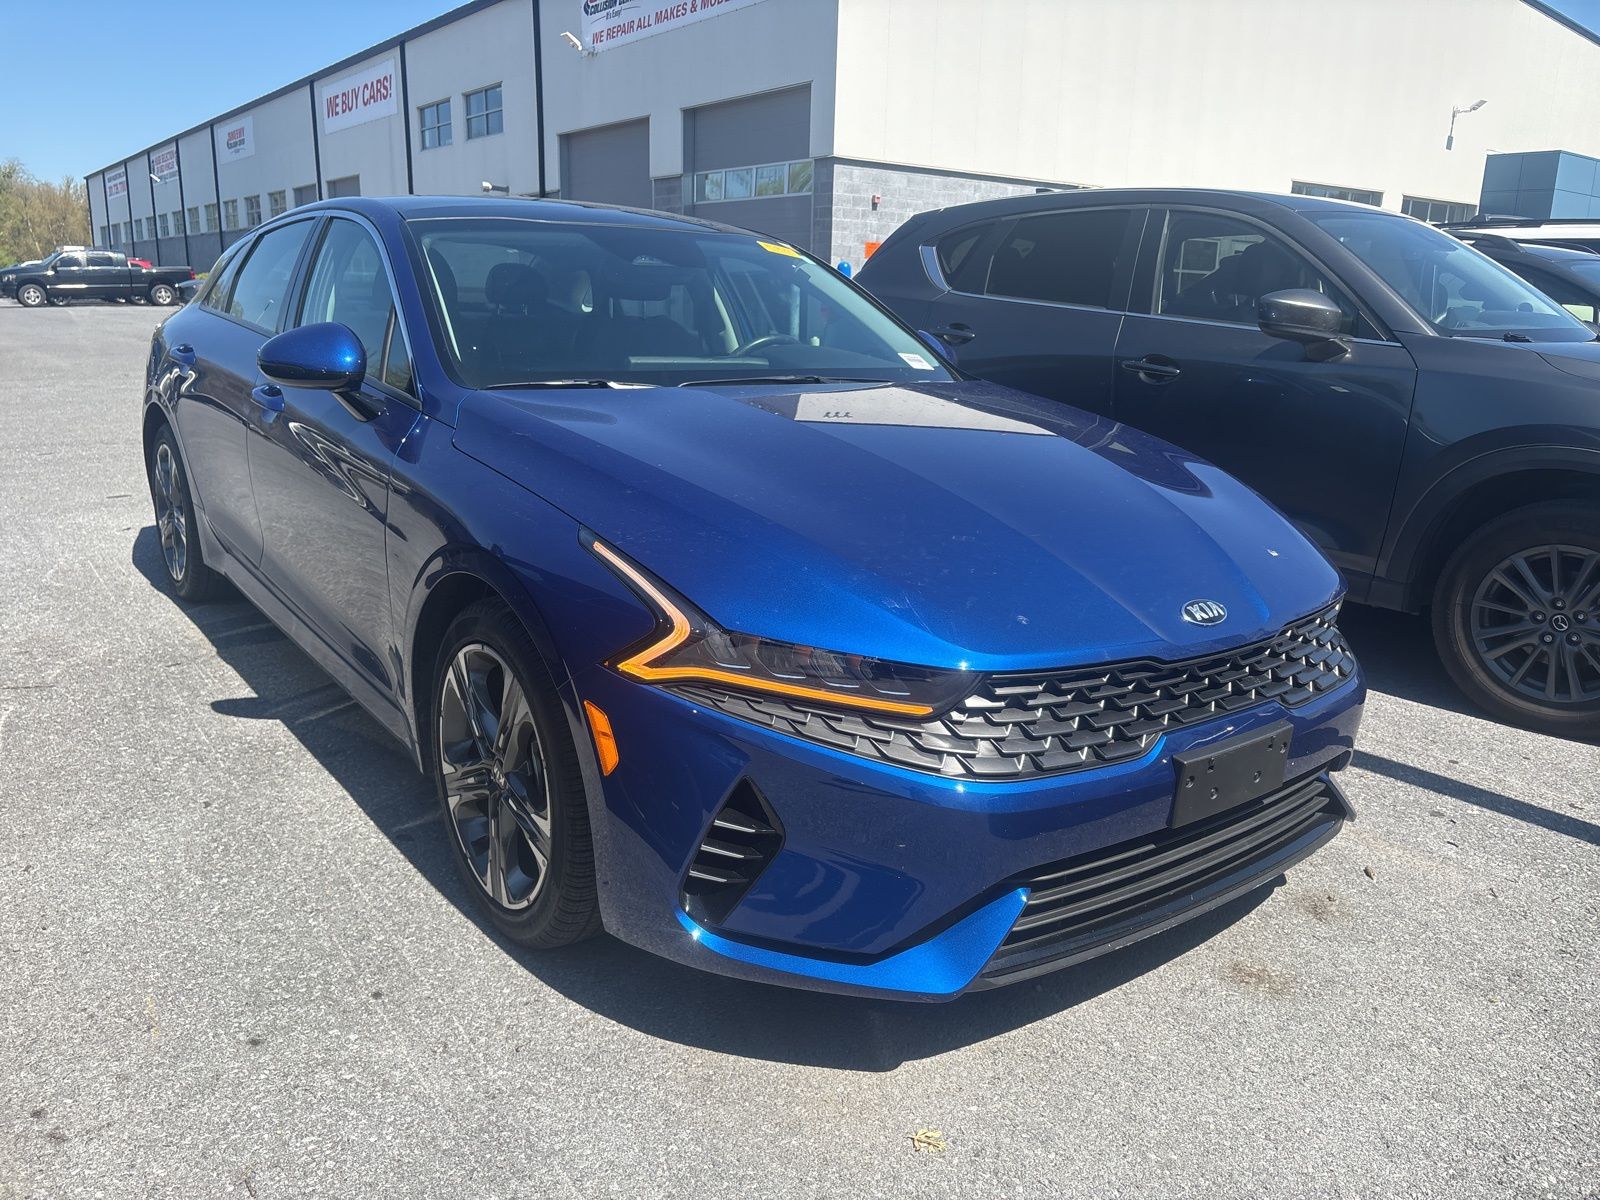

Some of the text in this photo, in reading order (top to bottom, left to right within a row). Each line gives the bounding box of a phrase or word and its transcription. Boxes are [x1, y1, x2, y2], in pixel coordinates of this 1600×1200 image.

[592, 30, 605, 45] WE
[606, 19, 635, 41] REPAIR
[636, 14, 653, 32] ALL
[655, 2, 687, 26] MAKES
[690, 0, 698, 13] &
[326, 74, 392, 119] WE BUY CARS!
[1186, 601, 1225, 621] KIA
